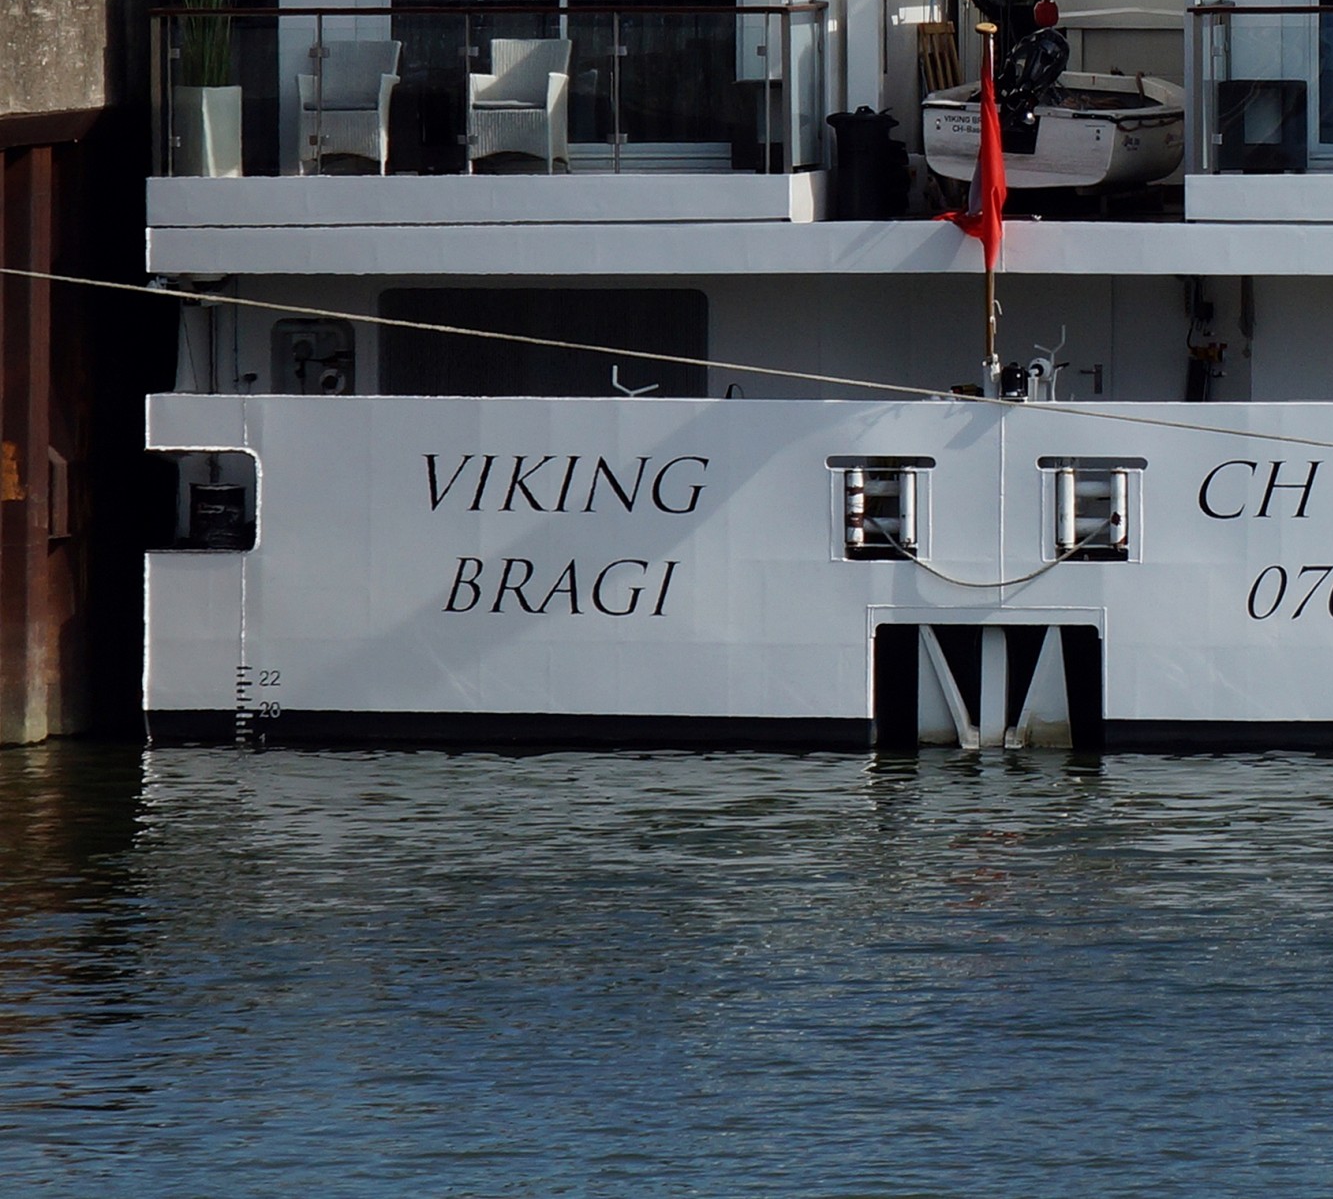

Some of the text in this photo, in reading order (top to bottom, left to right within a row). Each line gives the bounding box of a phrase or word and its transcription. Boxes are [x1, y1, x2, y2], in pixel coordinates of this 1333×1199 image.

[944, 114, 970, 124] VIKING
[423, 454, 710, 515] VIKING
[1199, 459, 1323, 521] CH
[441, 557, 681, 617] BRAGI
[259, 670, 281, 687] 22
[259, 701, 281, 719] 20
